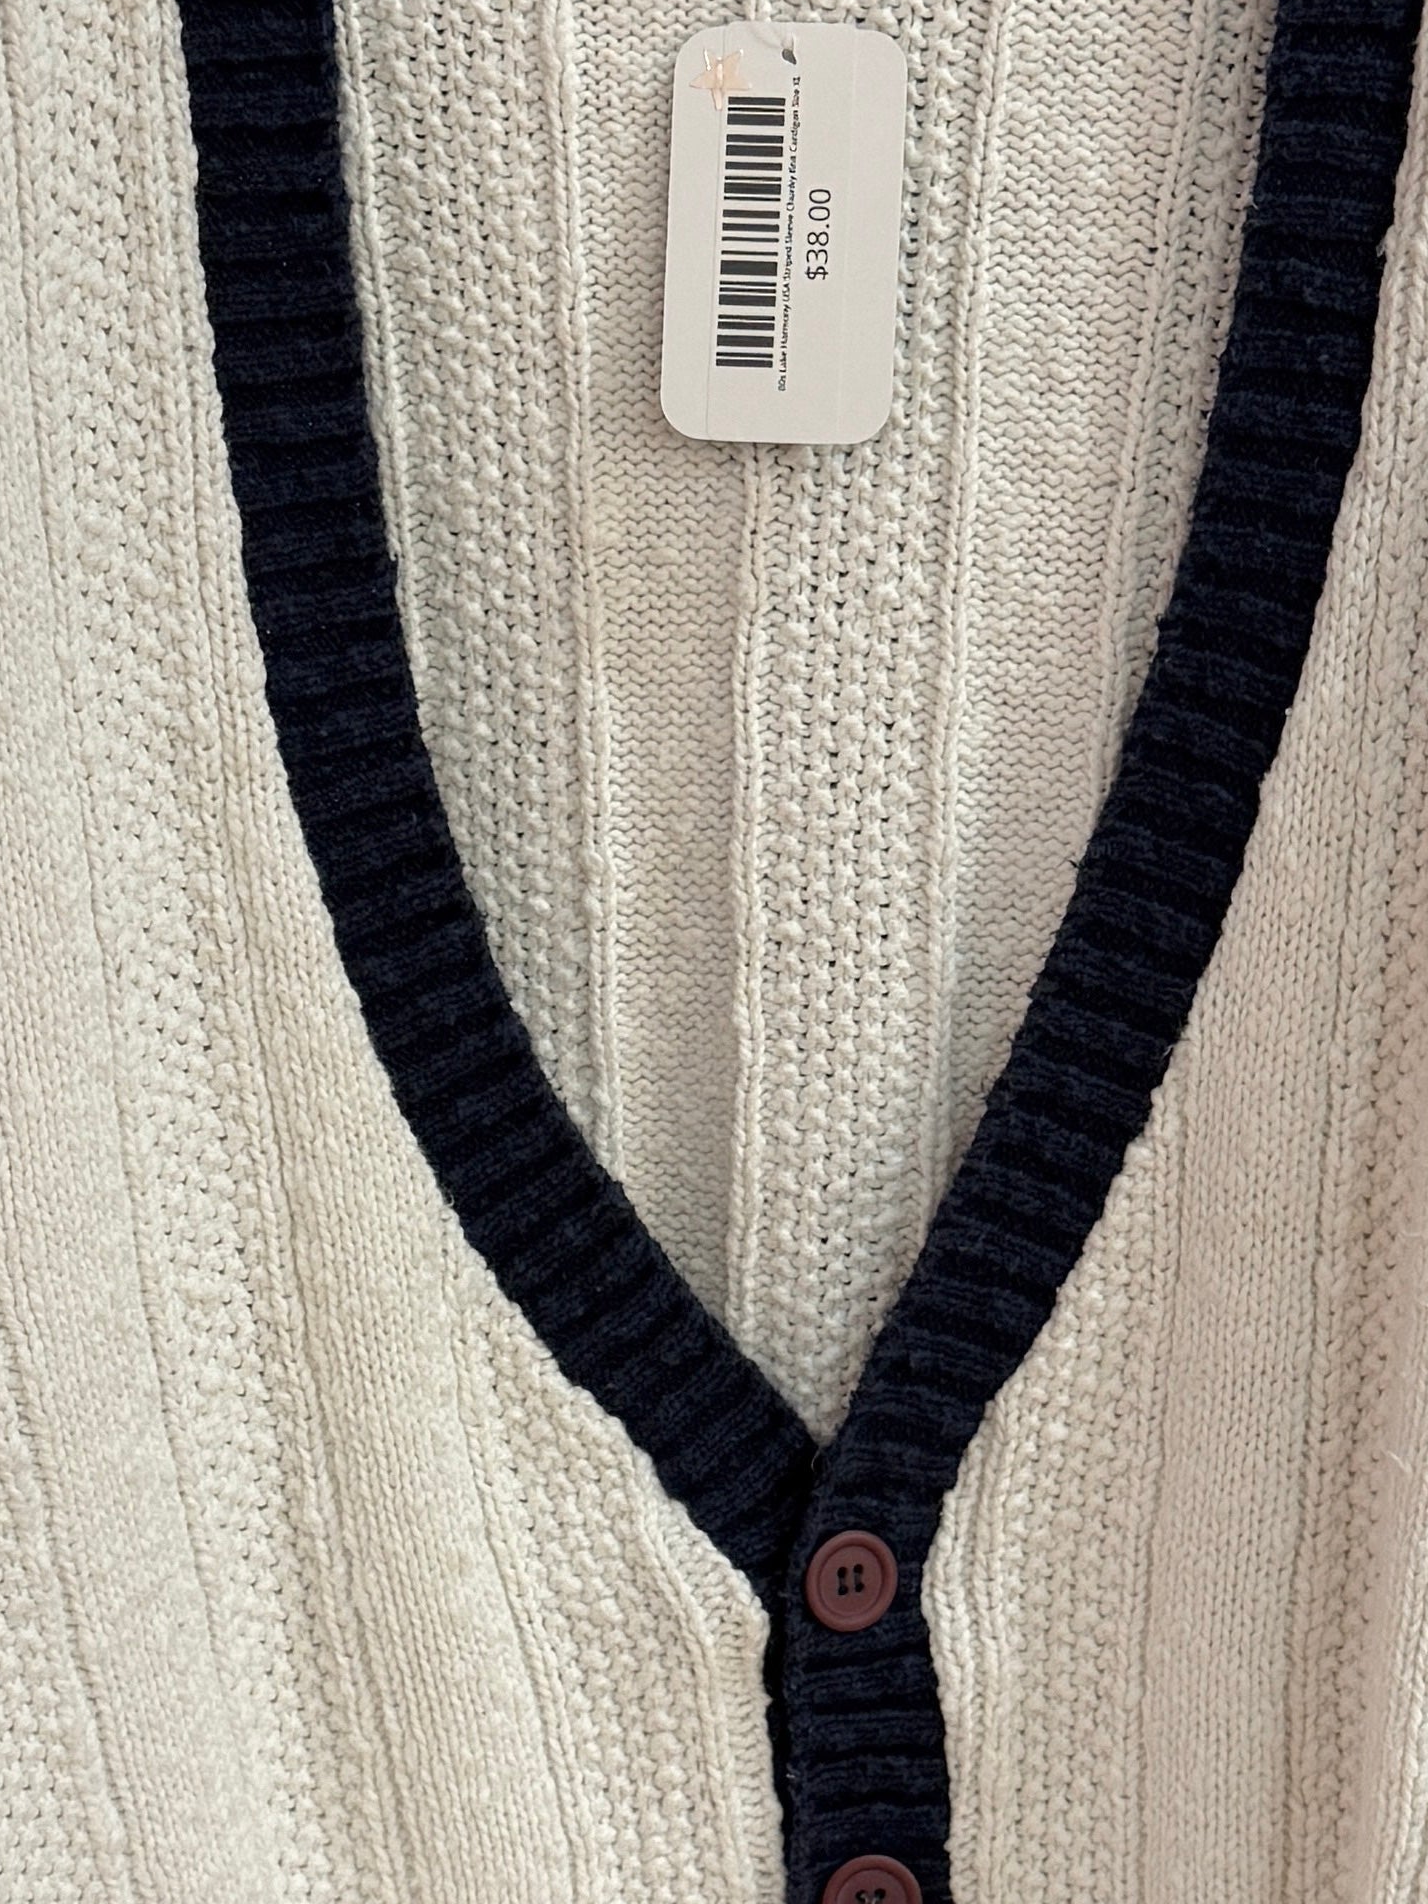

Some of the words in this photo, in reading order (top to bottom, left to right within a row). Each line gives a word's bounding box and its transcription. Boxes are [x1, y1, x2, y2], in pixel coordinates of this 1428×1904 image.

[789, 109, 801, 153] Cardigan
[785, 214, 794, 244] Sleeve
[806, 187, 832, 281] $38.00
[781, 282, 791, 302] USA
[780, 304, 791, 349] Harmony
[779, 352, 788, 373] Lake
